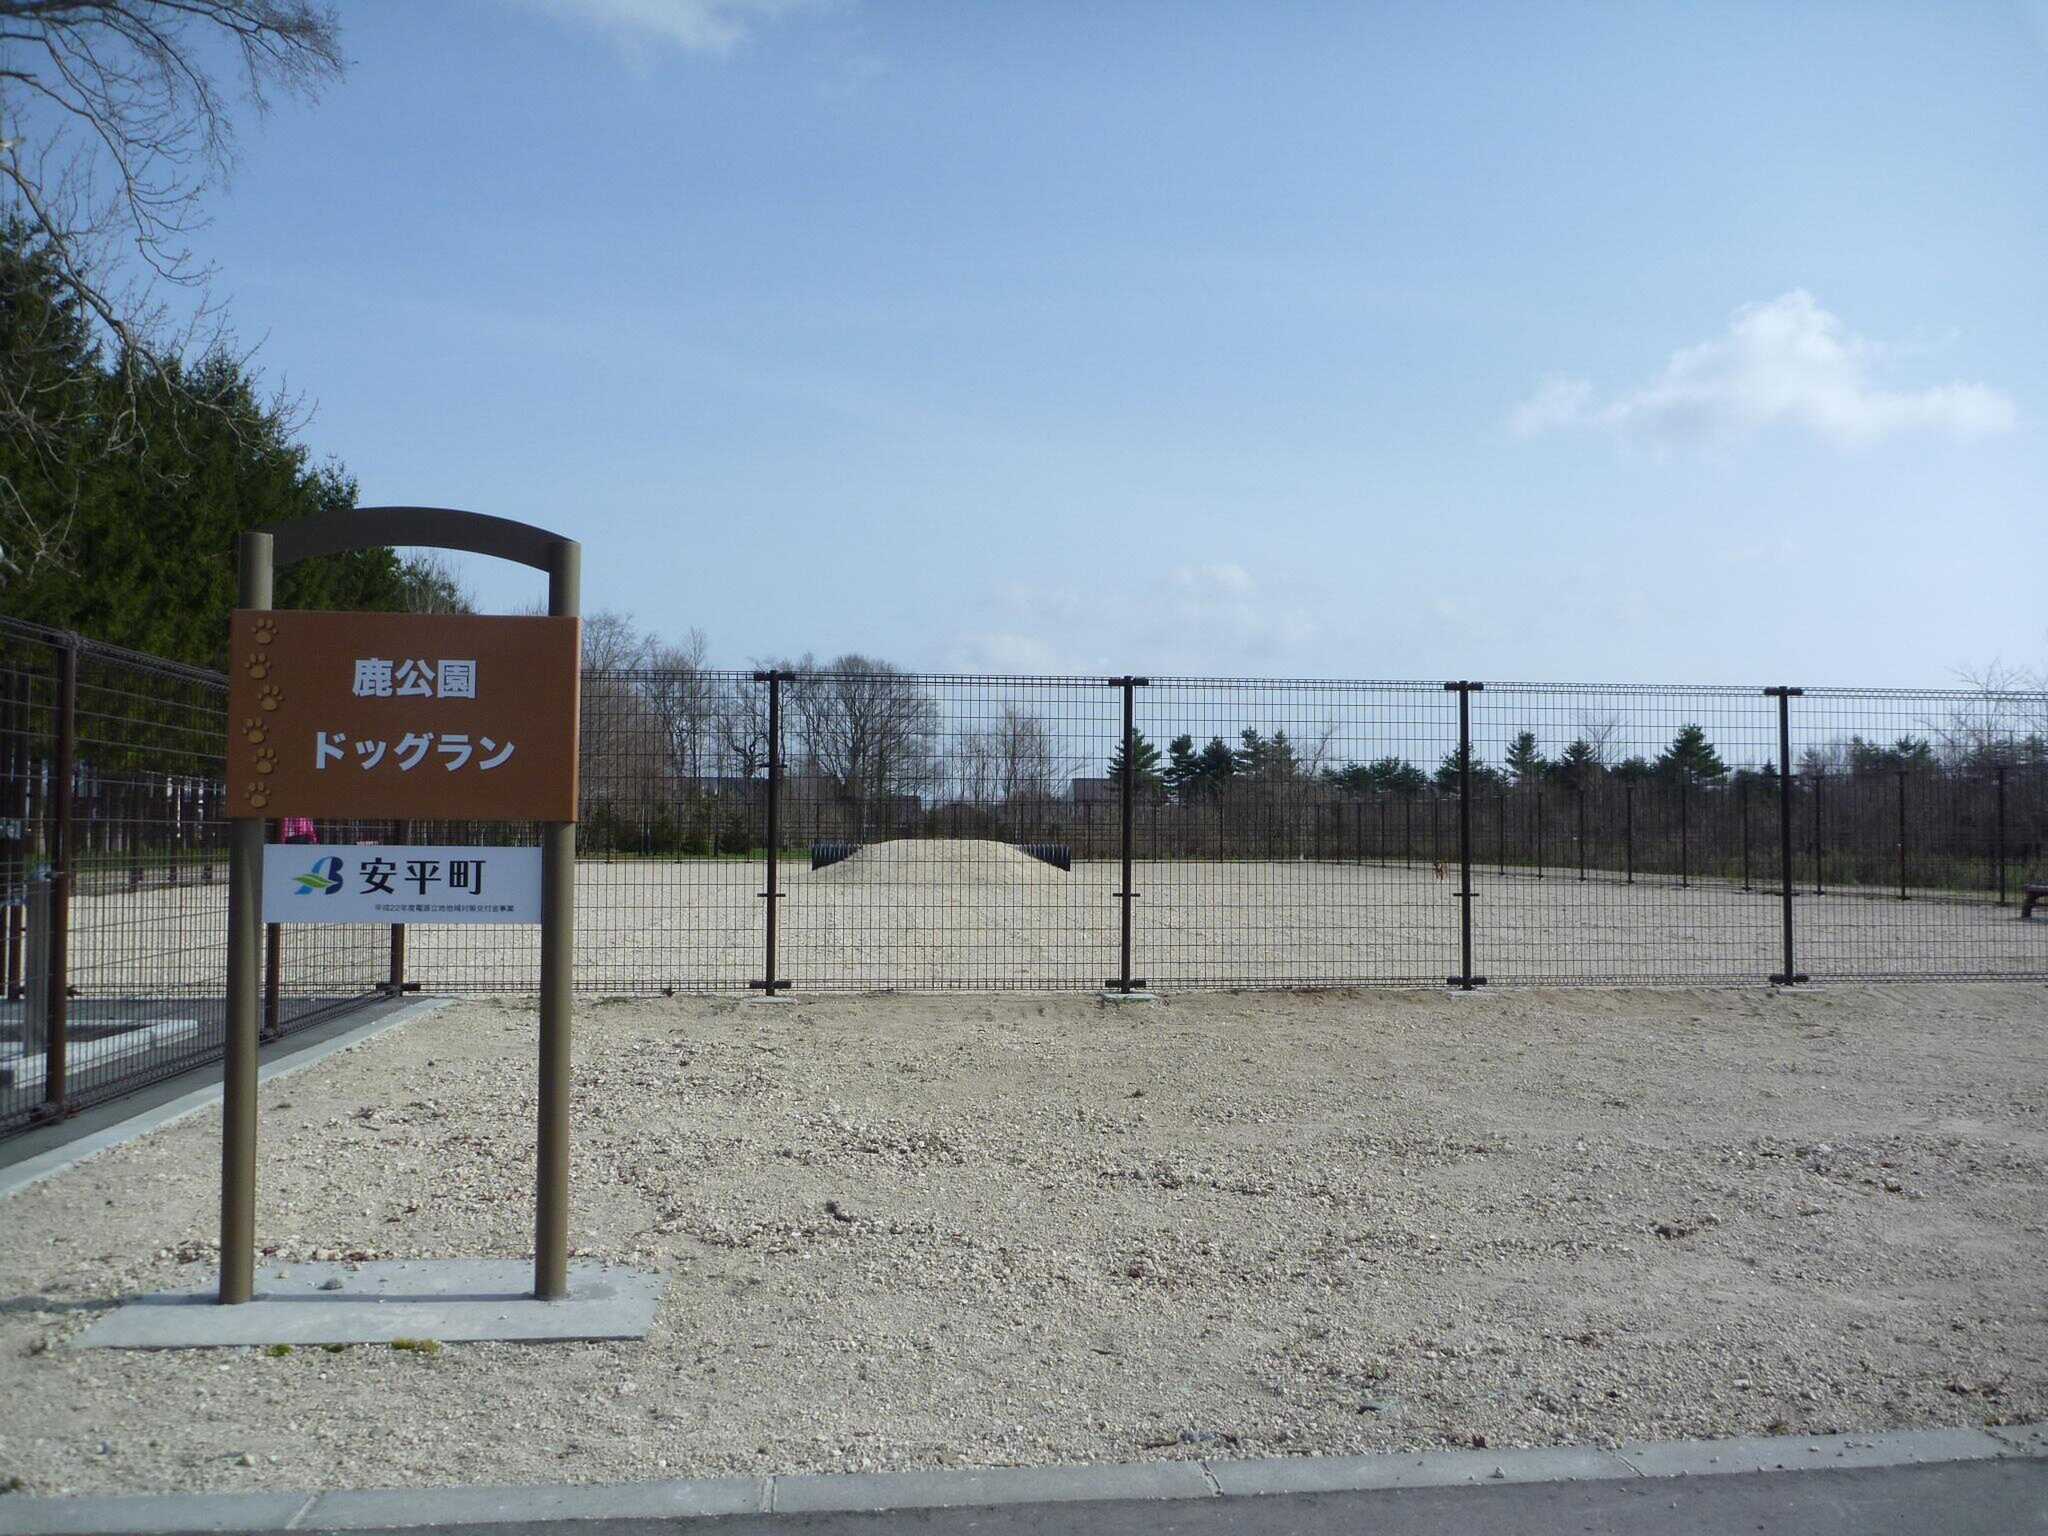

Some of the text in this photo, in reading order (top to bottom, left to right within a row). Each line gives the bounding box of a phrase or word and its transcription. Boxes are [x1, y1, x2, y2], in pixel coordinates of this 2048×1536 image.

[352, 658, 477, 699] 鹿公園
[315, 731, 514, 772] ドッグラン
[359, 857, 487, 895] 安平町
